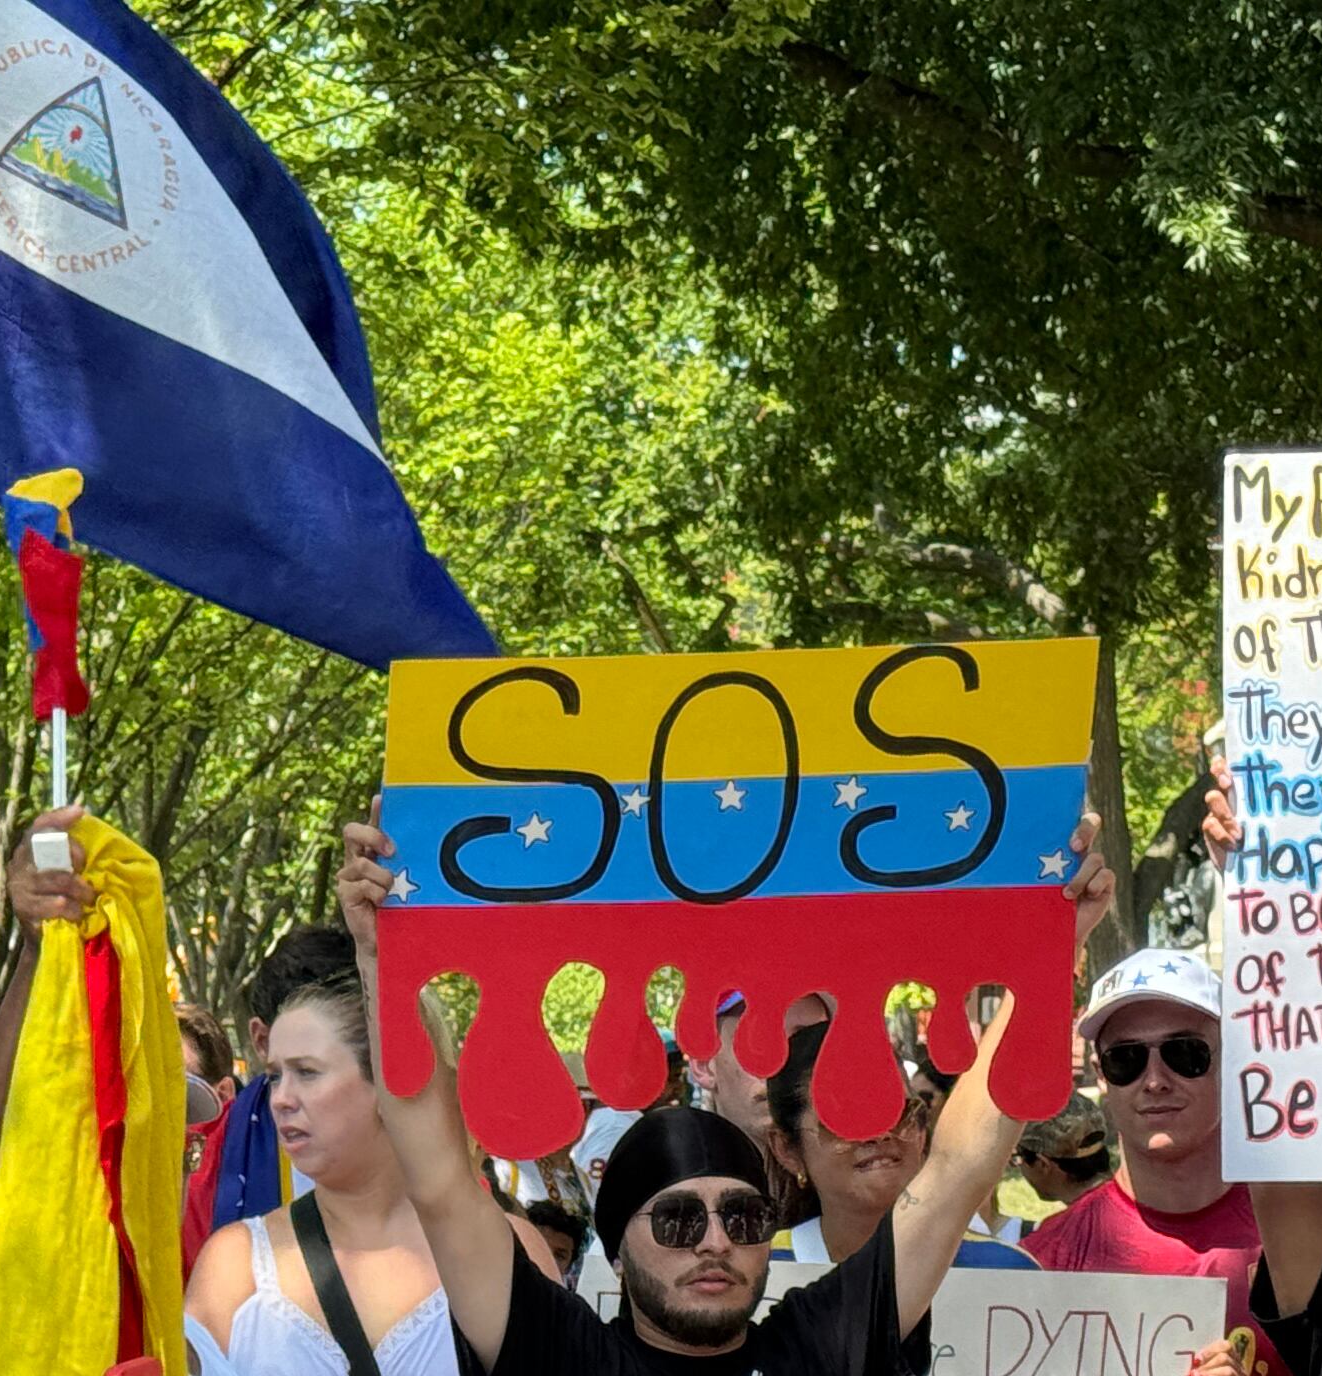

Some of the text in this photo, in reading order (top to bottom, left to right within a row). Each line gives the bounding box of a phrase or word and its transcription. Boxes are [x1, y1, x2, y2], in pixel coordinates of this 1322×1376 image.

[84, 53, 111, 76] DE
[56, 234, 152, 273] CENTRAL
[1233, 465, 1303, 543] My
[439, 645, 1008, 905] SOS
